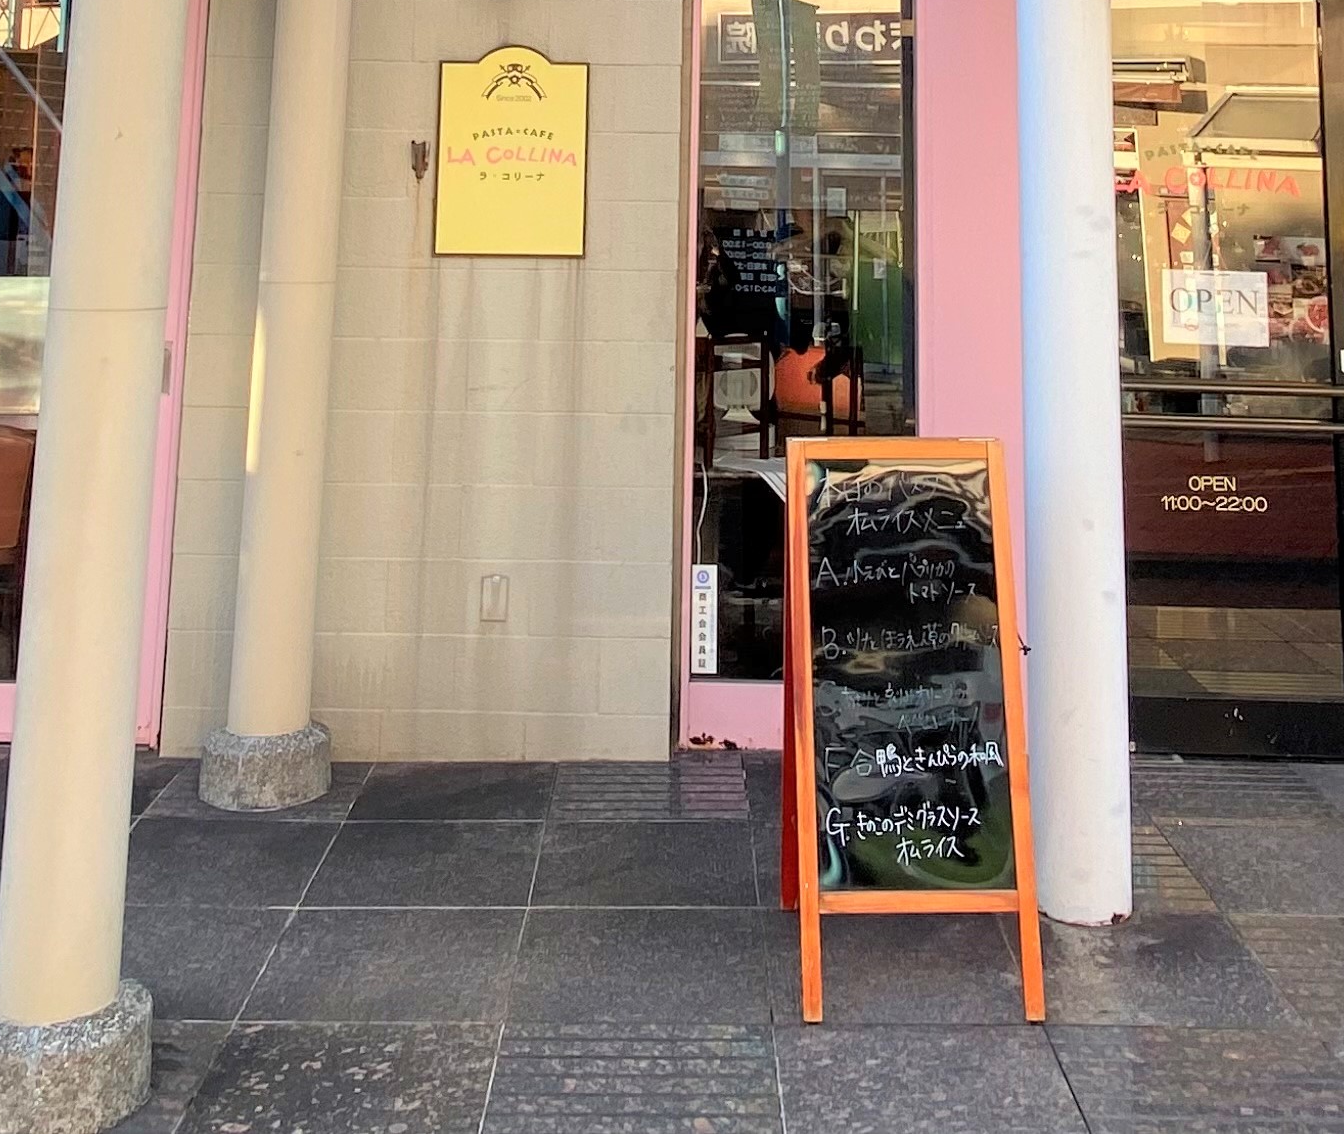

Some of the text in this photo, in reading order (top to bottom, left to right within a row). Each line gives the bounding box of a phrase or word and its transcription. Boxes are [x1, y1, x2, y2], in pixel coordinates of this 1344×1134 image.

[472, 127, 555, 141] PASTA CAFE
[447, 146, 476, 166] LA
[479, 171, 545, 182] ラ・コリーナ
[1170, 287, 1260, 315] OPEN
[1187, 475, 1237, 492] OPEN
[895, 835, 966, 867] オムライス
